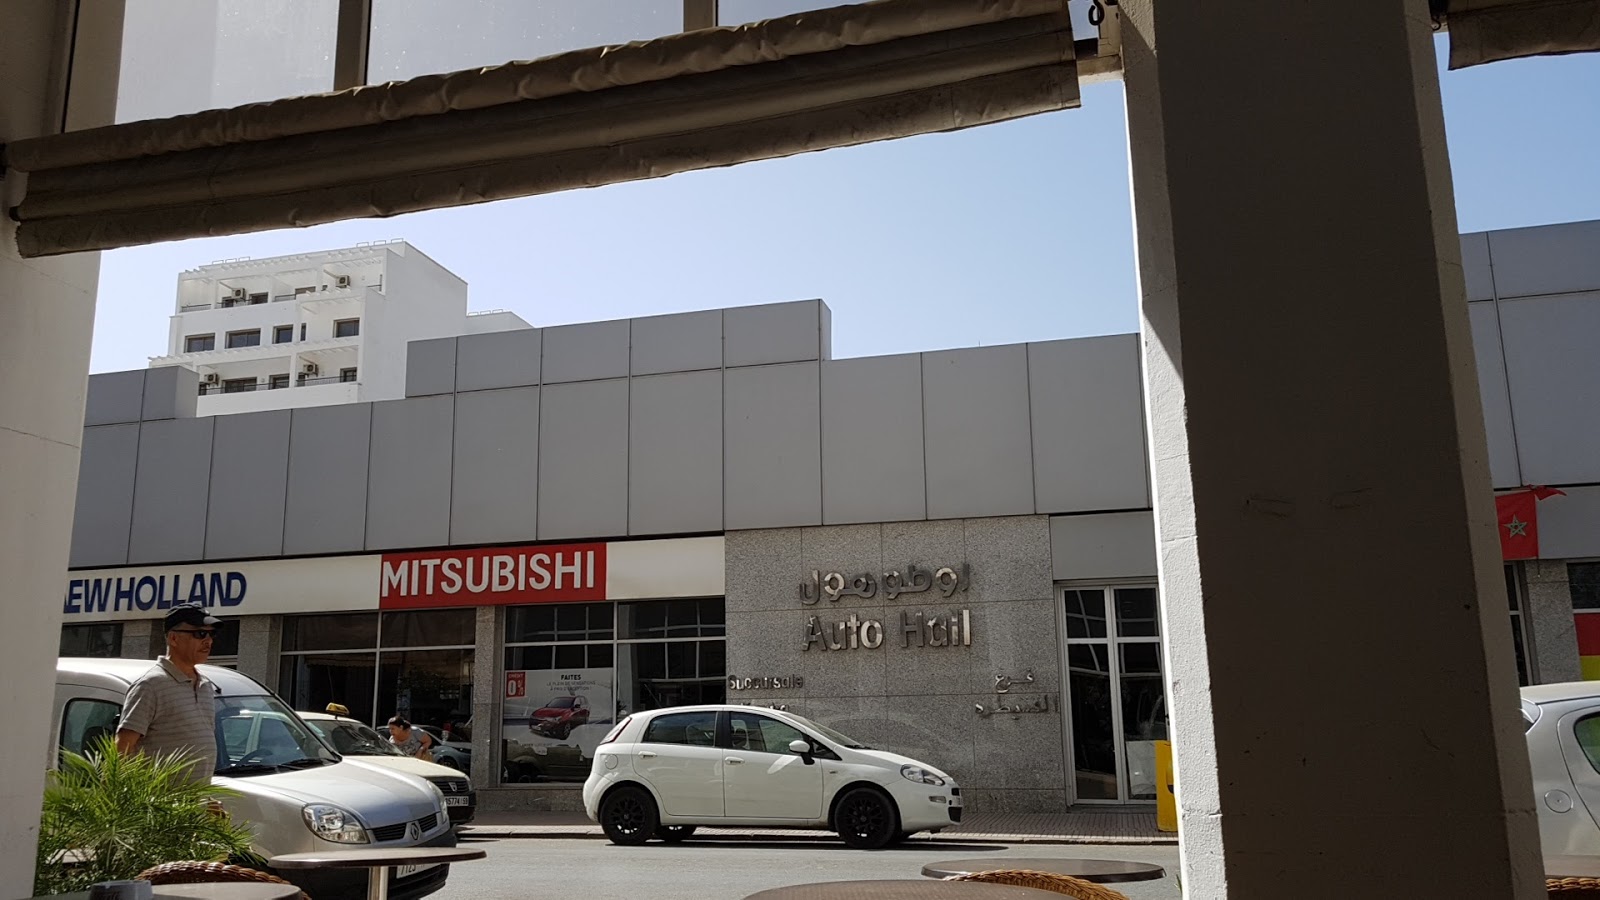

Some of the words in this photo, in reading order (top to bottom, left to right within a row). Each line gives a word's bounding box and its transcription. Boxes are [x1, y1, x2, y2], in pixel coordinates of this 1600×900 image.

[64, 578, 112, 614] EW
[114, 572, 247, 612] HOLLAND
[382, 551, 595, 597] MITSUBISHI
[802, 613, 884, 651] Auto
[728, 675, 804, 691] Succursale
